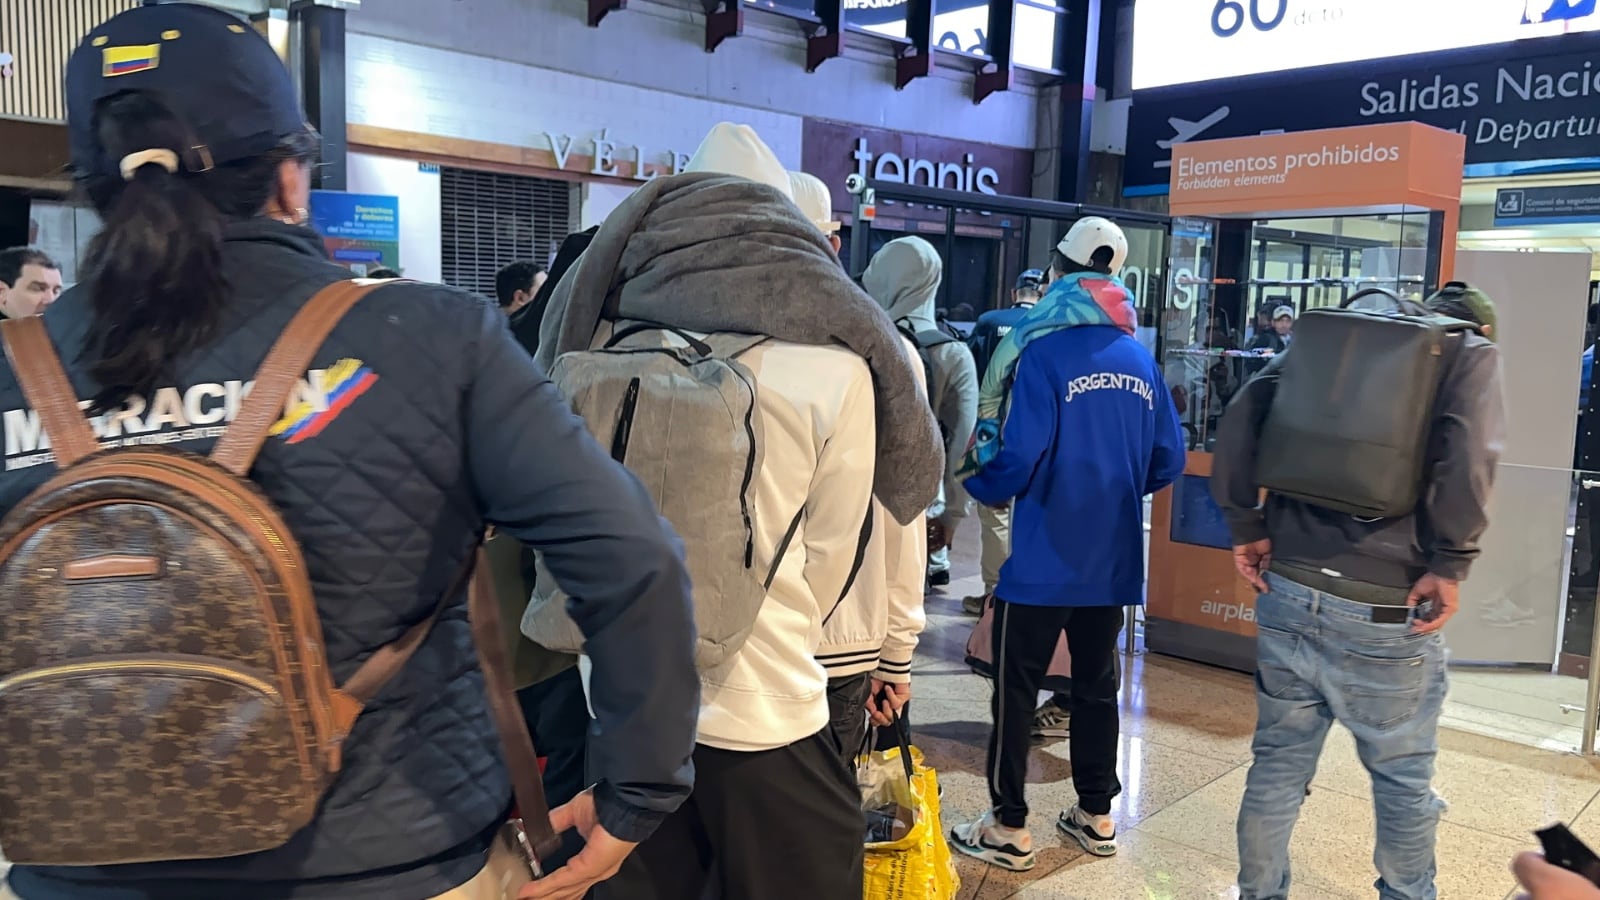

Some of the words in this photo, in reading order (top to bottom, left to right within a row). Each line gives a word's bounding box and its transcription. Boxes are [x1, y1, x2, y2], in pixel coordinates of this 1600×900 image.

[1360, 74, 1480, 116] Salidas
[854, 137, 1000, 215] tennis
[1178, 155, 1278, 178] Elementos
[1284, 142, 1400, 174] prohibidos
[1176, 175, 1231, 191] Forbidden
[1234, 172, 1286, 187] elements
[1065, 372, 1154, 410] ARGENTINA
